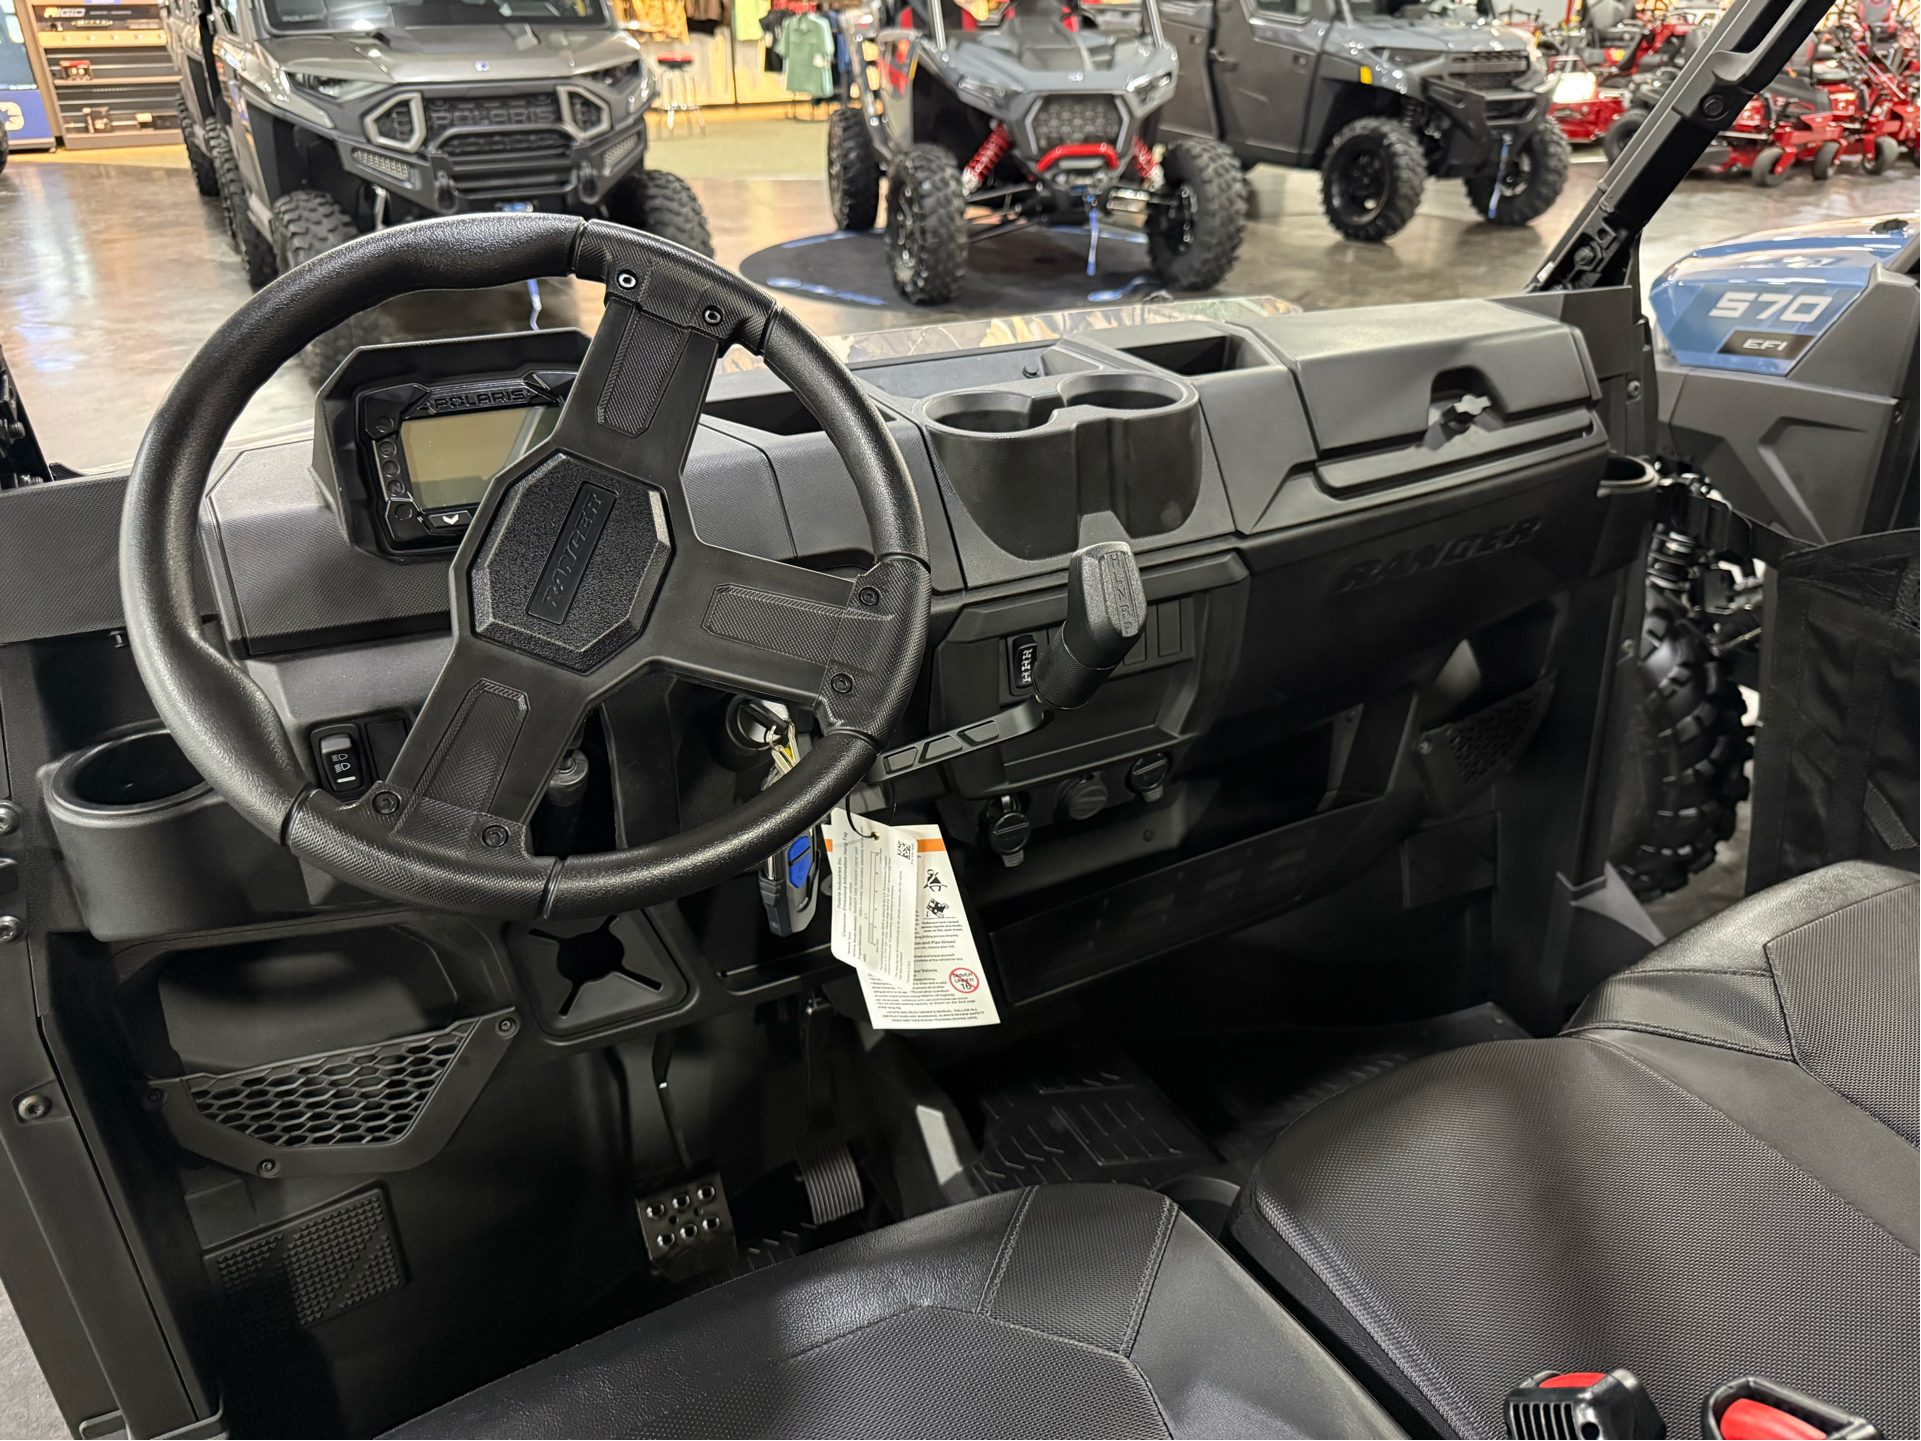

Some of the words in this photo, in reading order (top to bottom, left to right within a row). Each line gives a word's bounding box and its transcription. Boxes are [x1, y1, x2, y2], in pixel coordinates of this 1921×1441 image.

[1708, 291, 1833, 322] 570
[1742, 338, 1788, 351] EFI
[433, 389, 525, 410] POLARIS
[541, 492, 602, 612] RANGER
[1335, 516, 1542, 592] RANGER
